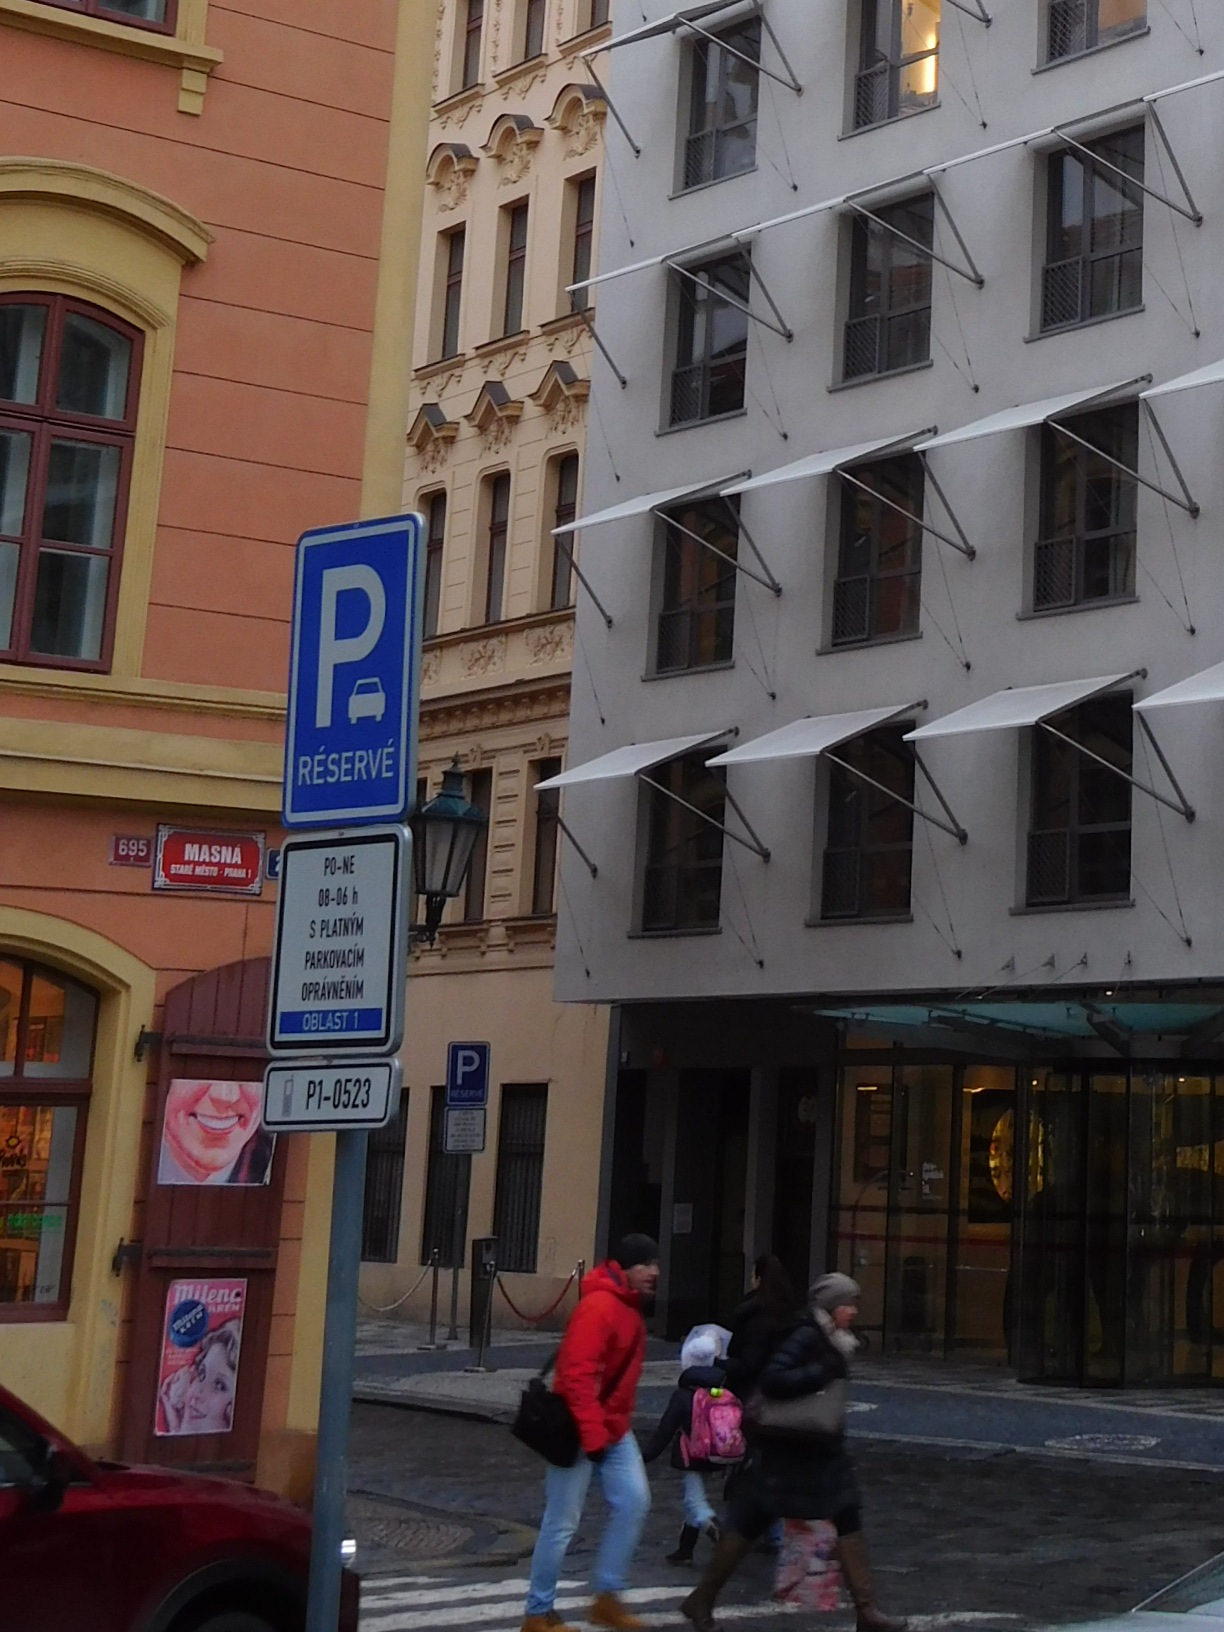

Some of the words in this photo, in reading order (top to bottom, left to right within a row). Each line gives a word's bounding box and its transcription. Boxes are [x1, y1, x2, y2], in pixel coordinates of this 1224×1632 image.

[315, 563, 386, 729] P
[298, 738, 395, 786] RÉSERVÉ
[118, 839, 148, 856] 695
[184, 843, 242, 864] MASNÁ
[324, 855, 355, 877] PO-NE
[318, 886, 348, 907] 08-06
[352, 885, 358, 905] h
[309, 919, 316, 939] S
[320, 912, 364, 939] PLATNÝM
[304, 943, 365, 970] PARKOVACÍM
[302, 974, 364, 1002] OPRÁVNĚNÍM
[302, 1011, 349, 1031] OBLAST
[353, 1012, 359, 1029] 1
[456, 1049, 480, 1085] P
[305, 1077, 372, 1110] P1-0523
